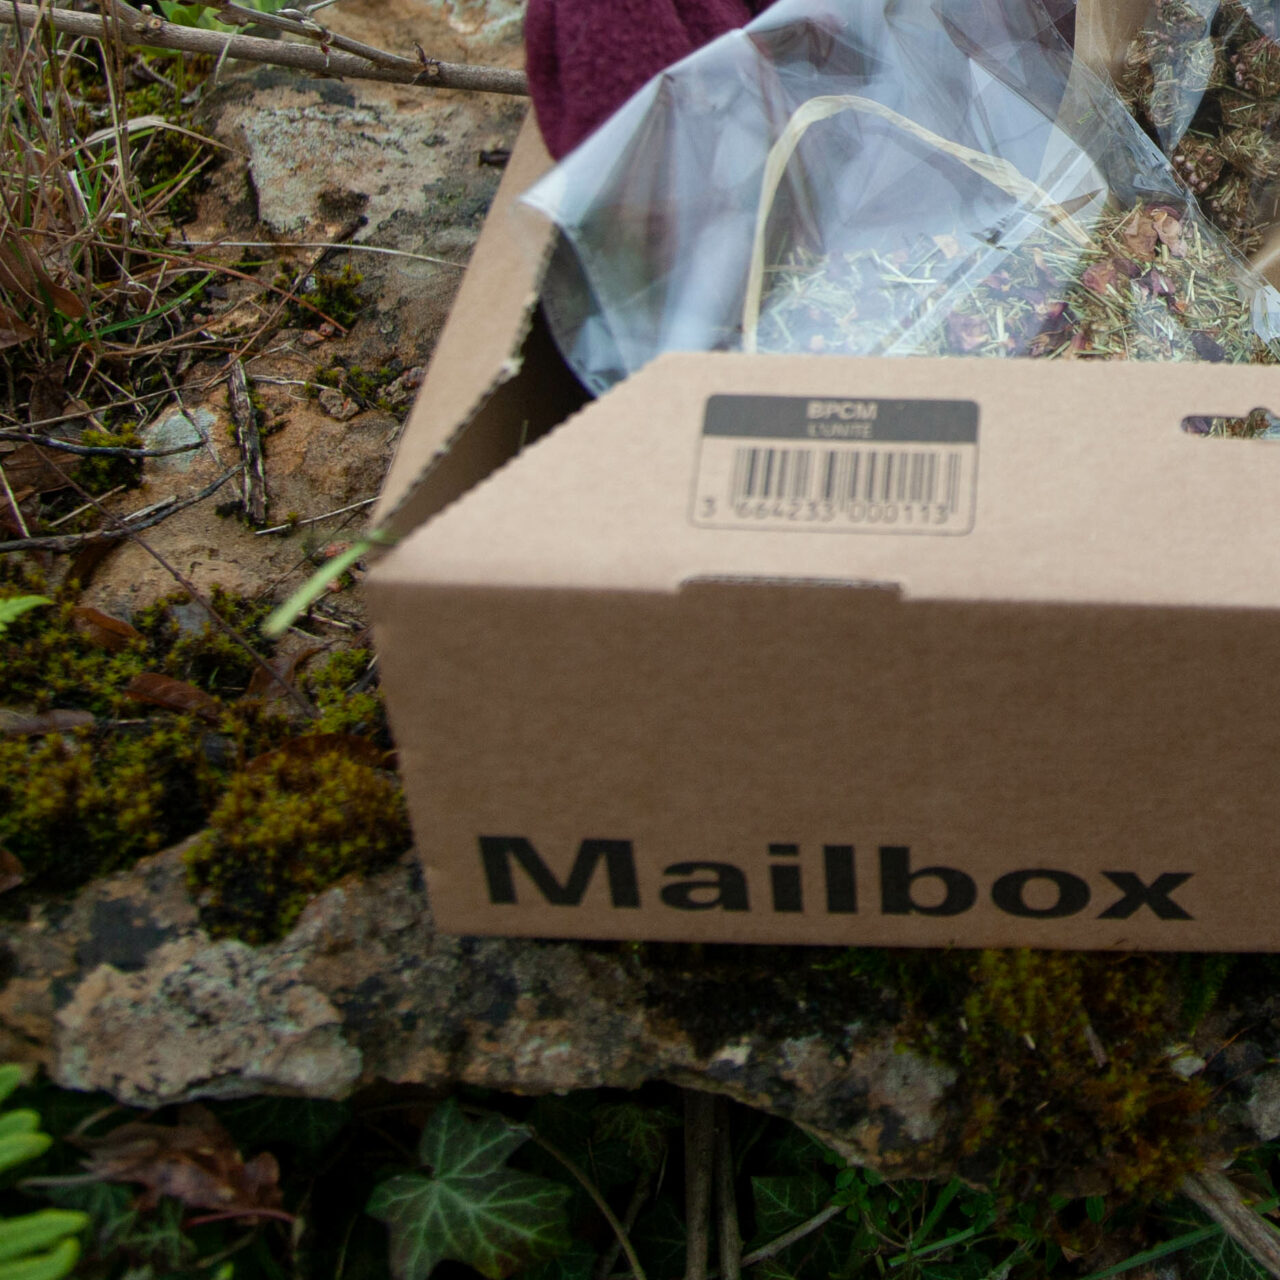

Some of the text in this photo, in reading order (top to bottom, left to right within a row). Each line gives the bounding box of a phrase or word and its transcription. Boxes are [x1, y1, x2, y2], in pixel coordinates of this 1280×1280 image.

[806, 400, 878, 420] BPCM
[702, 496, 717, 519] 3
[479, 835, 1195, 920] Mailbox
